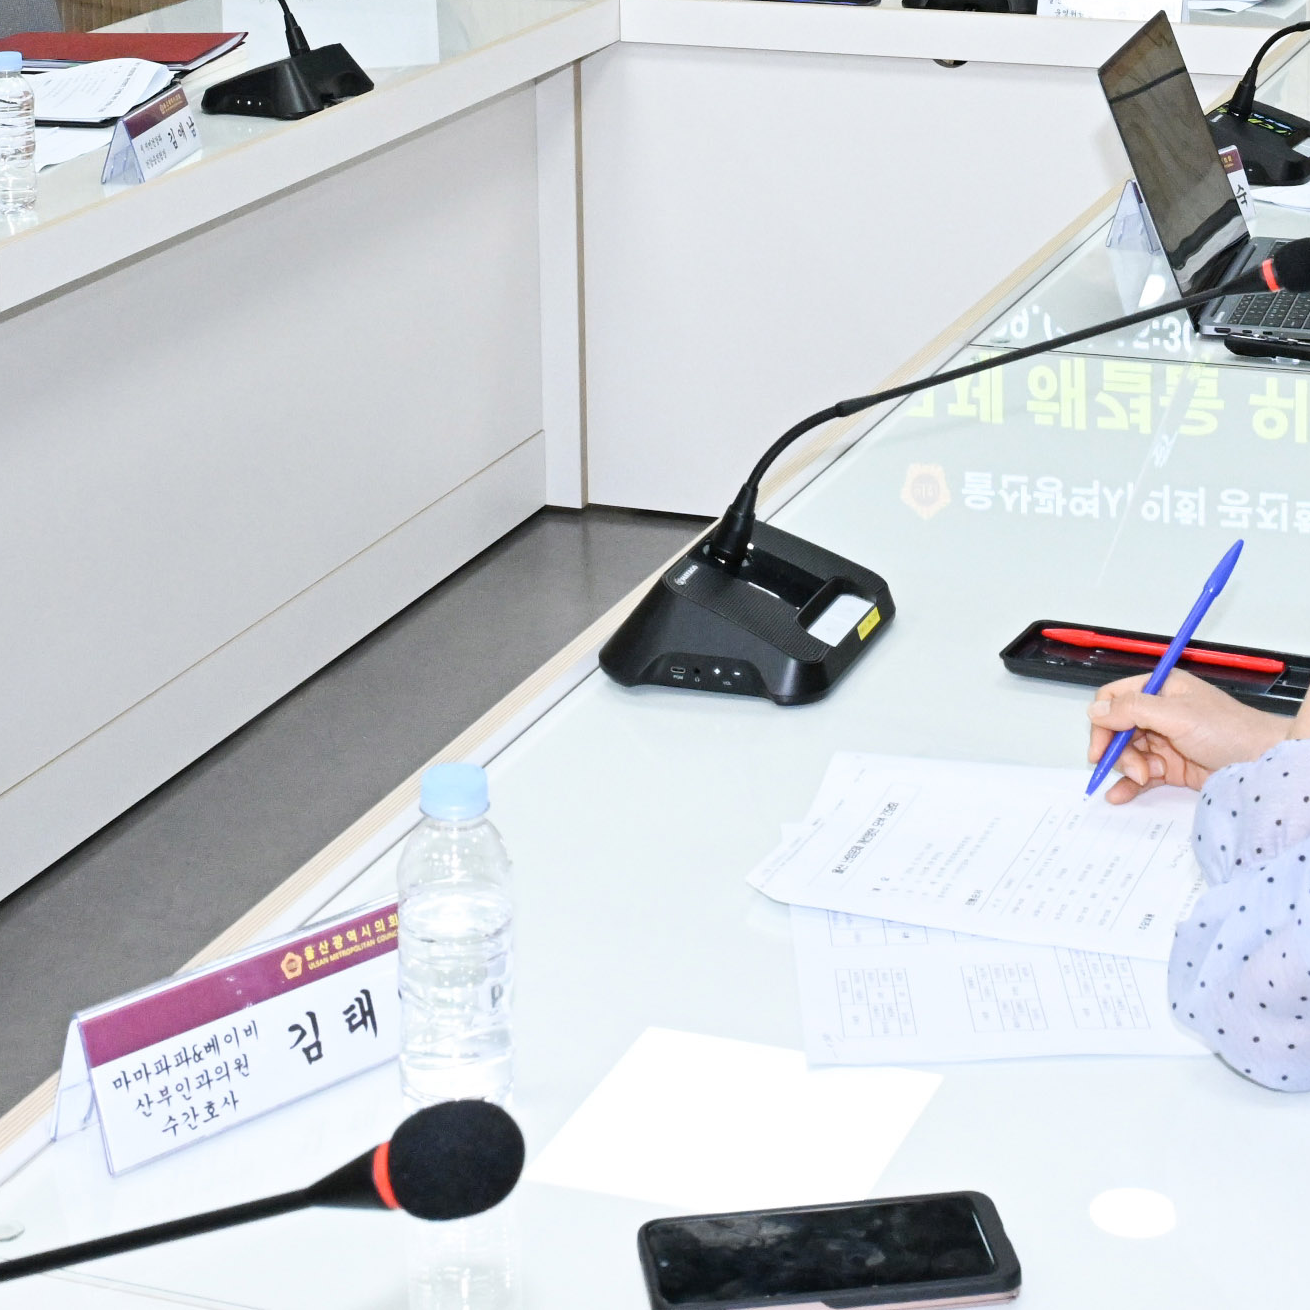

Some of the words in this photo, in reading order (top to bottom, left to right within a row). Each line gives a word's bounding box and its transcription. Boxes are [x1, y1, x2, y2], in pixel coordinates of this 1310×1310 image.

[303, 912, 398, 960] 울산광역시의회
[308, 956, 329, 971] ULSAN
[329, 939, 376, 965] METROPOLITAN
[377, 930, 398, 944] COUNC
[287, 988, 380, 1065] 김태
[112, 1020, 261, 1092] 마마파파&베이비
[135, 1054, 252, 1118] 산부인과의원
[162, 1090, 241, 1137] 수간호사
